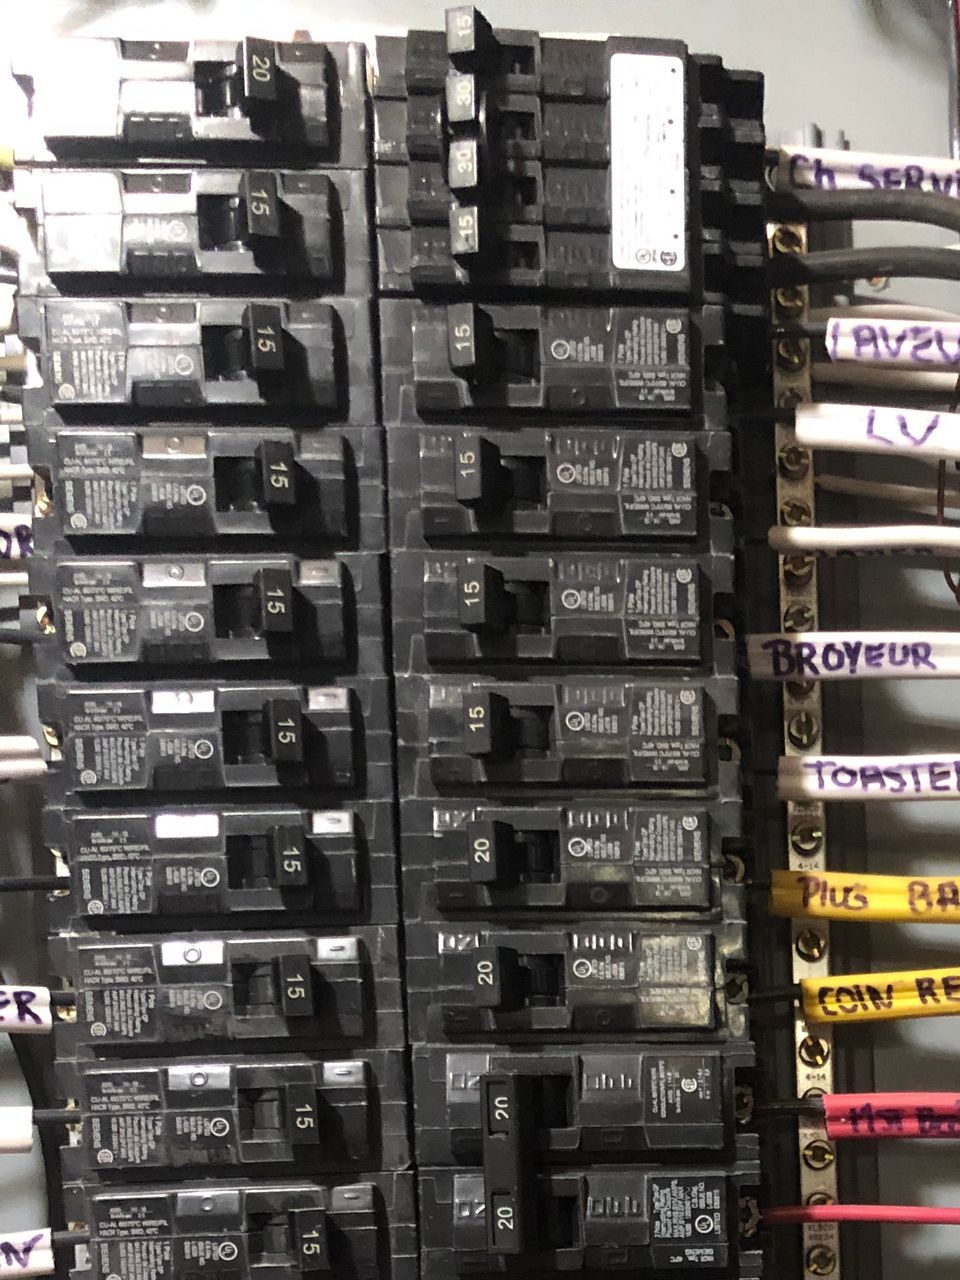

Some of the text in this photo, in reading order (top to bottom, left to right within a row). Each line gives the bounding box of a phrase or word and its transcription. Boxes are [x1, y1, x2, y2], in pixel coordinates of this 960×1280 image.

[458, 14, 472, 36] 15
[252, 54, 270, 83] 20
[457, 82, 472, 105] 30
[458, 150, 473, 173] 30
[251, 188, 269, 216] 15
[459, 215, 473, 238] 15
[257, 326, 276, 353] 15
[455, 325, 471, 351] 15
[866, 408, 940, 446] LV
[270, 462, 288, 488] 15
[460, 452, 475, 478] 15
[267, 588, 285, 614] 15
[464, 581, 480, 607] 15
[761, 639, 937, 677] BROYEUR
[277, 717, 296, 744] 15
[469, 706, 484, 732] 15
[284, 846, 302, 873] 15
[475, 838, 489, 863] 20
[478, 961, 493, 986] 20
[287, 974, 304, 1000] 15
[296, 1104, 313, 1129] 15
[495, 1096, 509, 1120] 20
[497, 1206, 513, 1230] 20
[302, 1230, 320, 1255] 15
